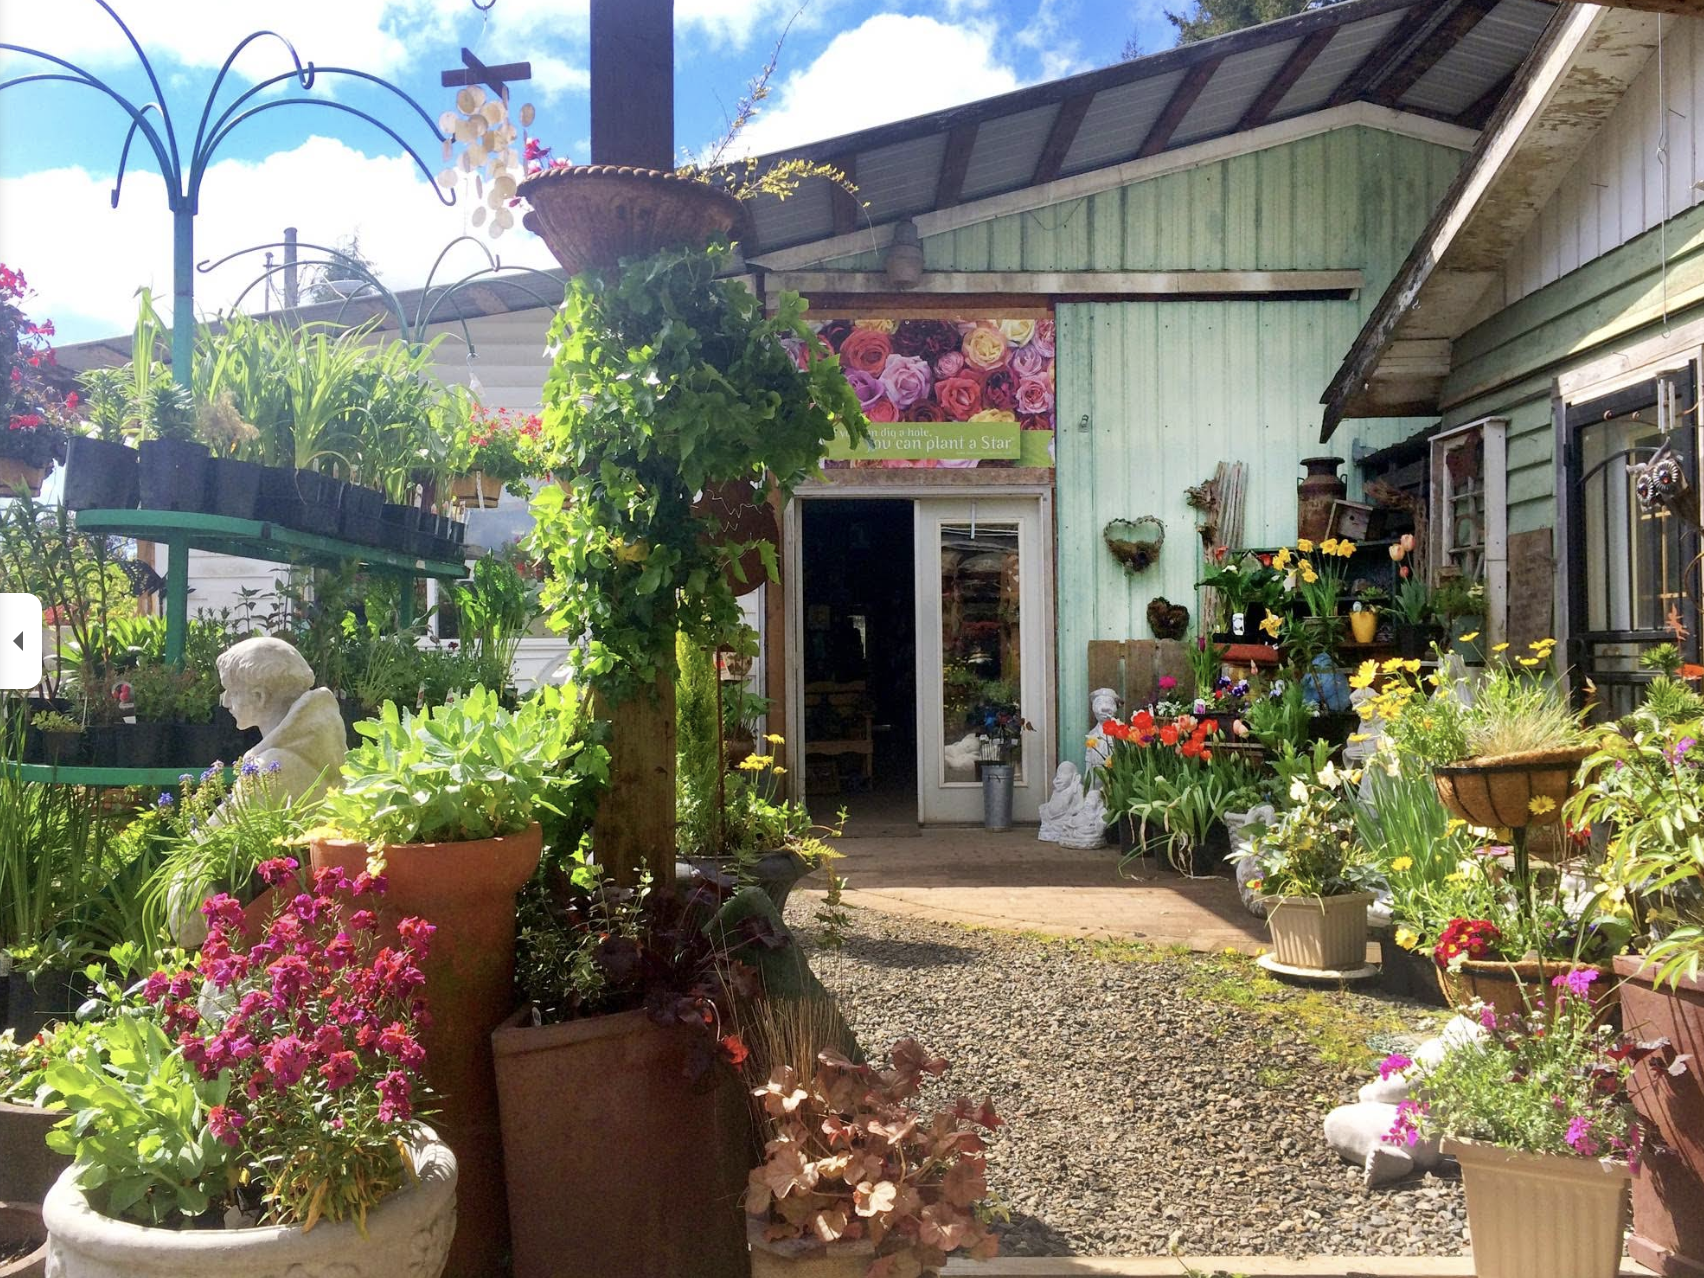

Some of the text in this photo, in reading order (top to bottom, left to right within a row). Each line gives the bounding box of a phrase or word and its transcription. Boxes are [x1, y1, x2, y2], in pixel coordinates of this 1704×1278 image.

[880, 427, 897, 439] dig
[868, 438, 891, 452] ou
[895, 439, 921, 450] can
[926, 435, 964, 453] plant
[968, 438, 977, 450] a
[981, 435, 1012, 450] Star
